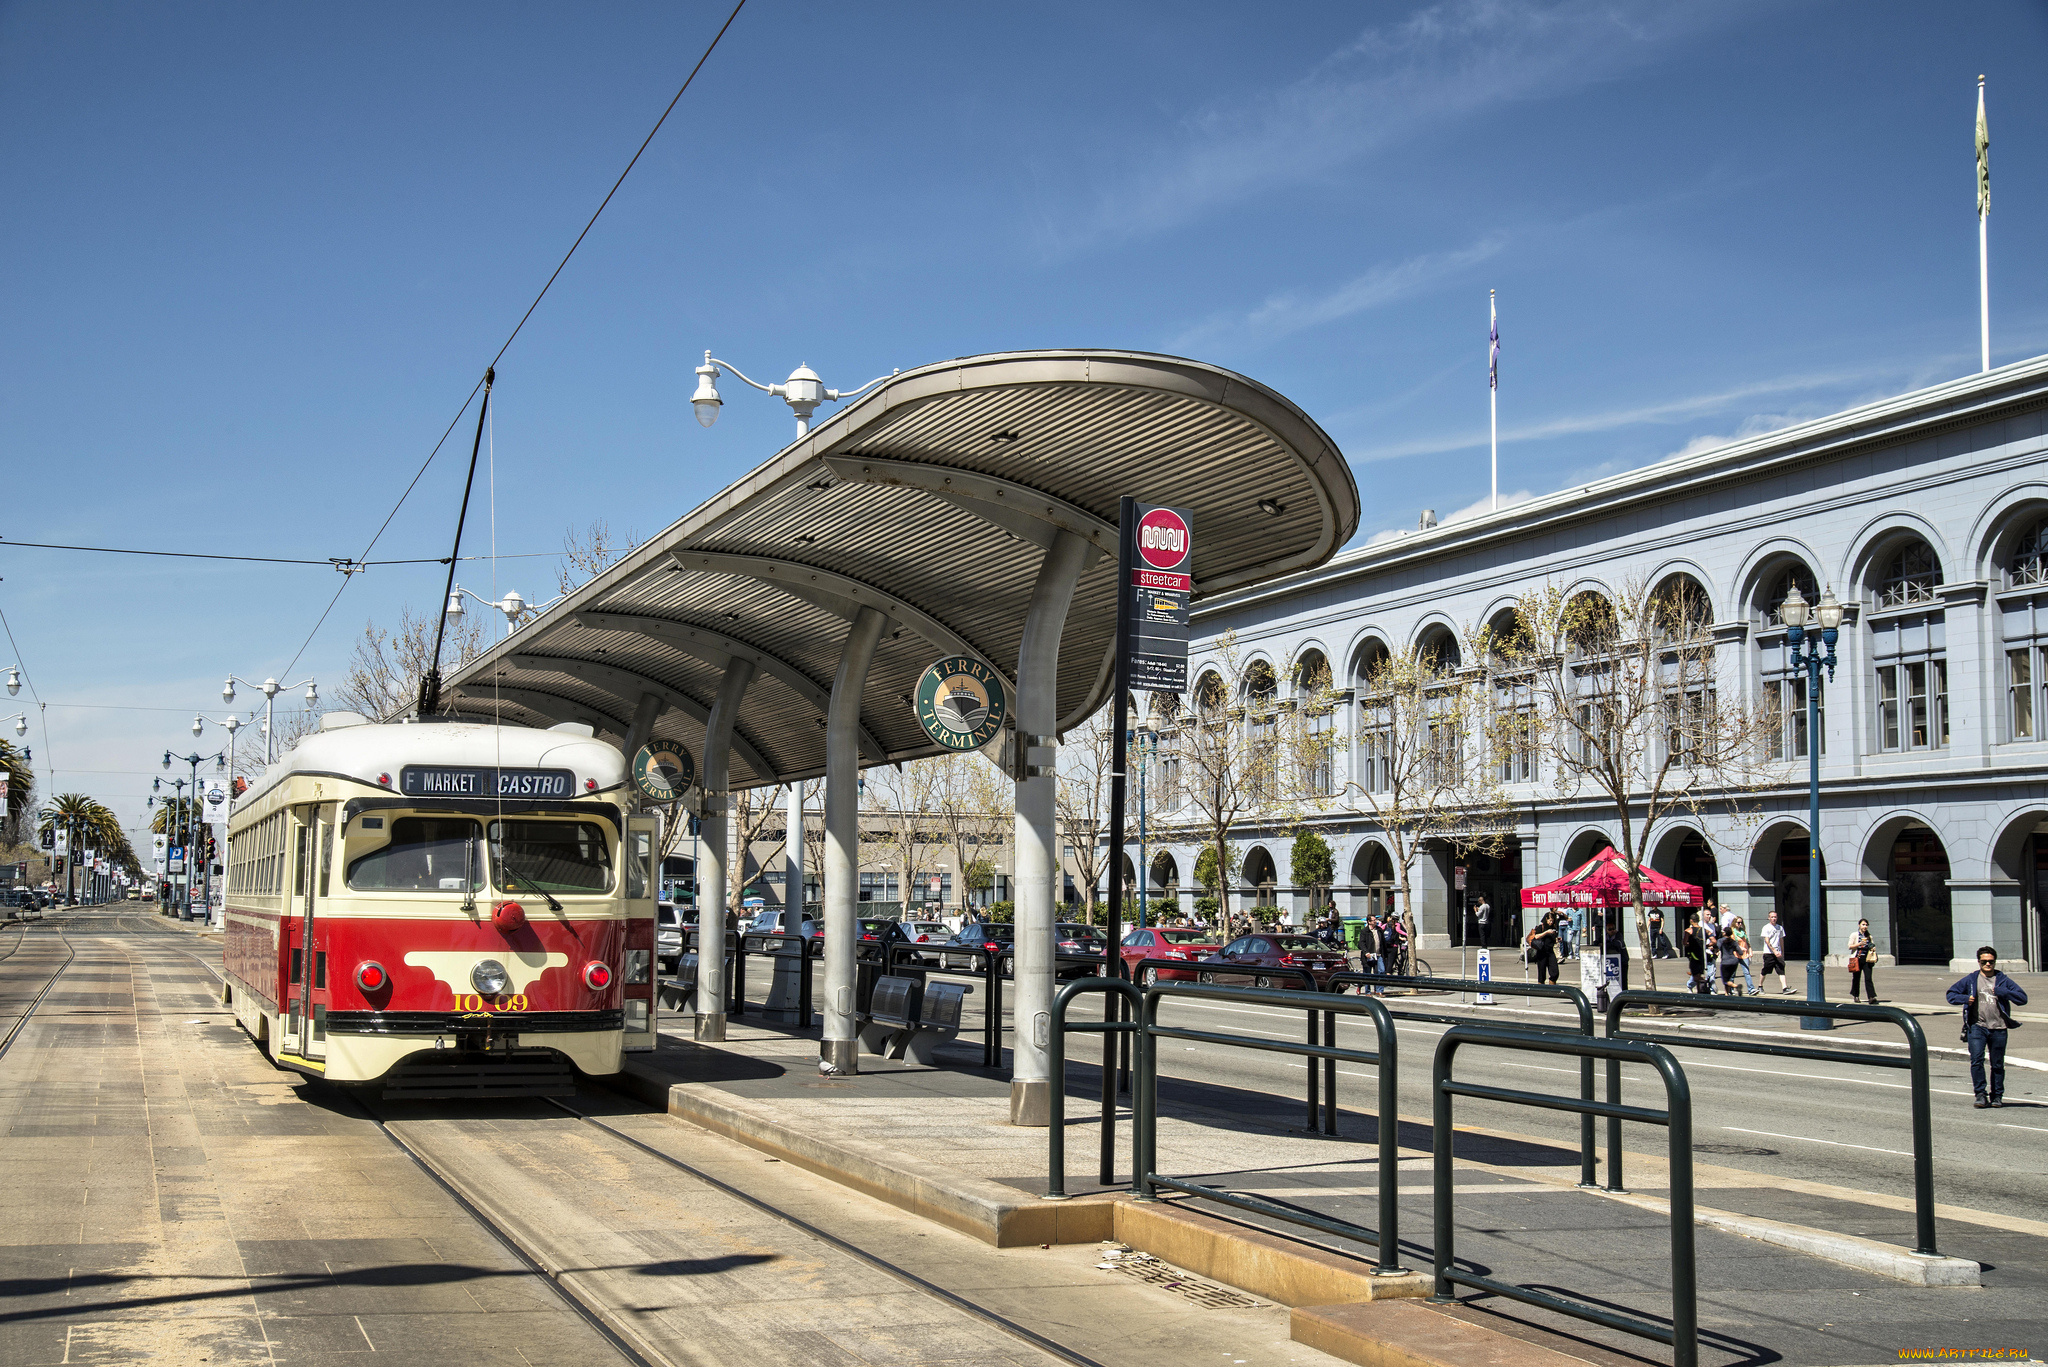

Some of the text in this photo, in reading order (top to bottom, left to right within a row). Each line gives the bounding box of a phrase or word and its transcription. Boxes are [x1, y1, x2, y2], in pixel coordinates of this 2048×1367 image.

[1140, 572, 1182, 587] streetcar
[1136, 588, 1143, 602] F
[932, 659, 994, 684] FERRY
[922, 708, 1001, 748] TERMINAL
[645, 741, 687, 757] FERRY
[406, 772, 565, 794] F MARKET CASTRO
[638, 774, 692, 799] TERMINAL
[1532, 891, 1546, 905] Ferry
[1547, 890, 1569, 904] Building
[1570, 890, 1592, 904] Parking
[1618, 890, 1632, 902] Ferr
[1642, 890, 1664, 904] uilding
[1665, 889, 1691, 904] Parking
